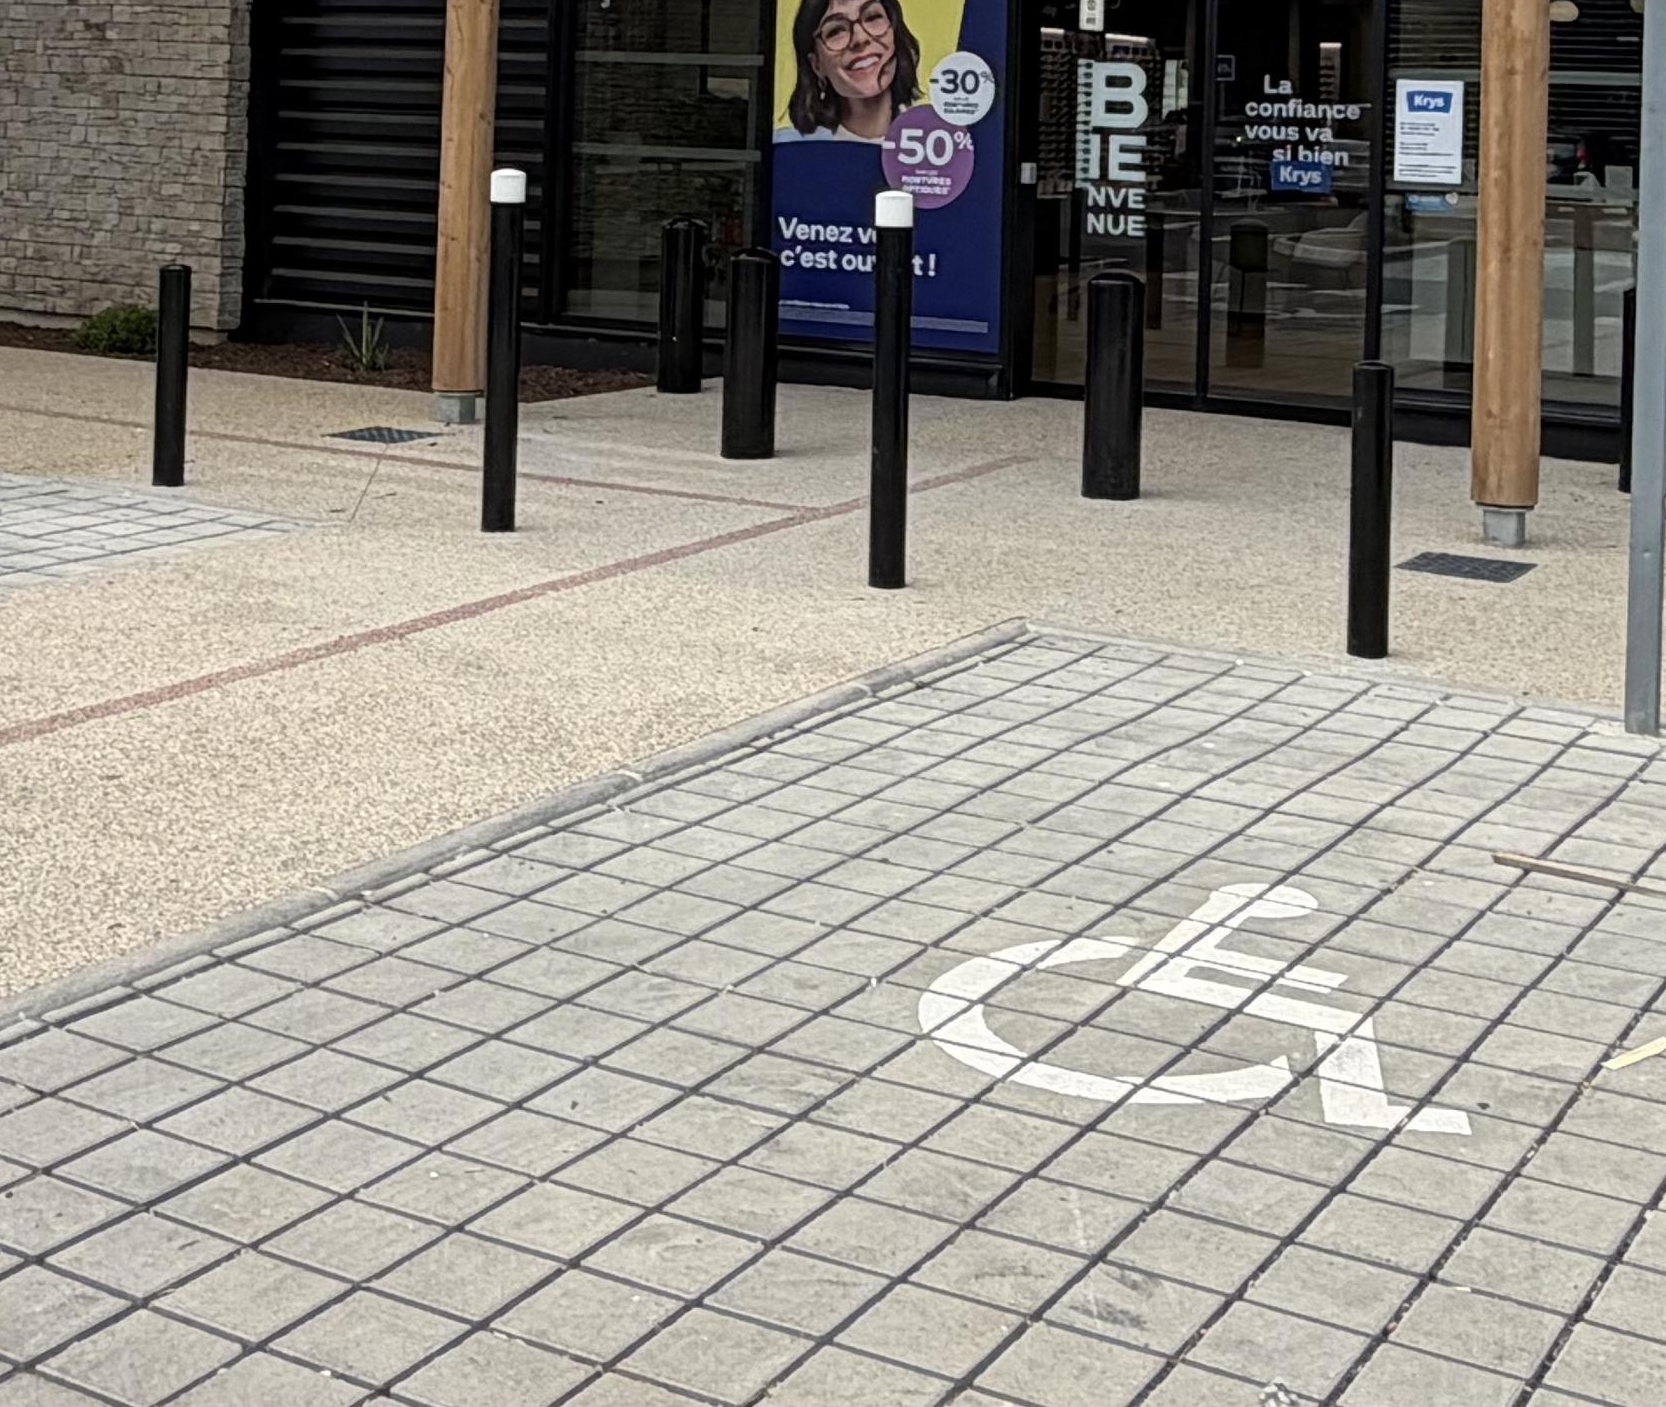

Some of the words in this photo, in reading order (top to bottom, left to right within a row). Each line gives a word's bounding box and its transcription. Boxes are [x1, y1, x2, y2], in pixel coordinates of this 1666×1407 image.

[1263, 73, 1293, 94] La
[1244, 98, 1361, 120] confiance
[1413, 94, 1445, 110] Krys
[1244, 124, 1300, 141] vous
[1305, 126, 1333, 142] va
[1272, 144, 1292, 162] si
[1298, 144, 1350, 167] bien
[1279, 165, 1322, 187] Krys
[1087, 186, 1146, 210] NVE
[778, 216, 854, 244] Venez
[1087, 213, 1146, 237] NUE
[780, 245, 837, 270] c'est
[928, 253, 937, 277] !
